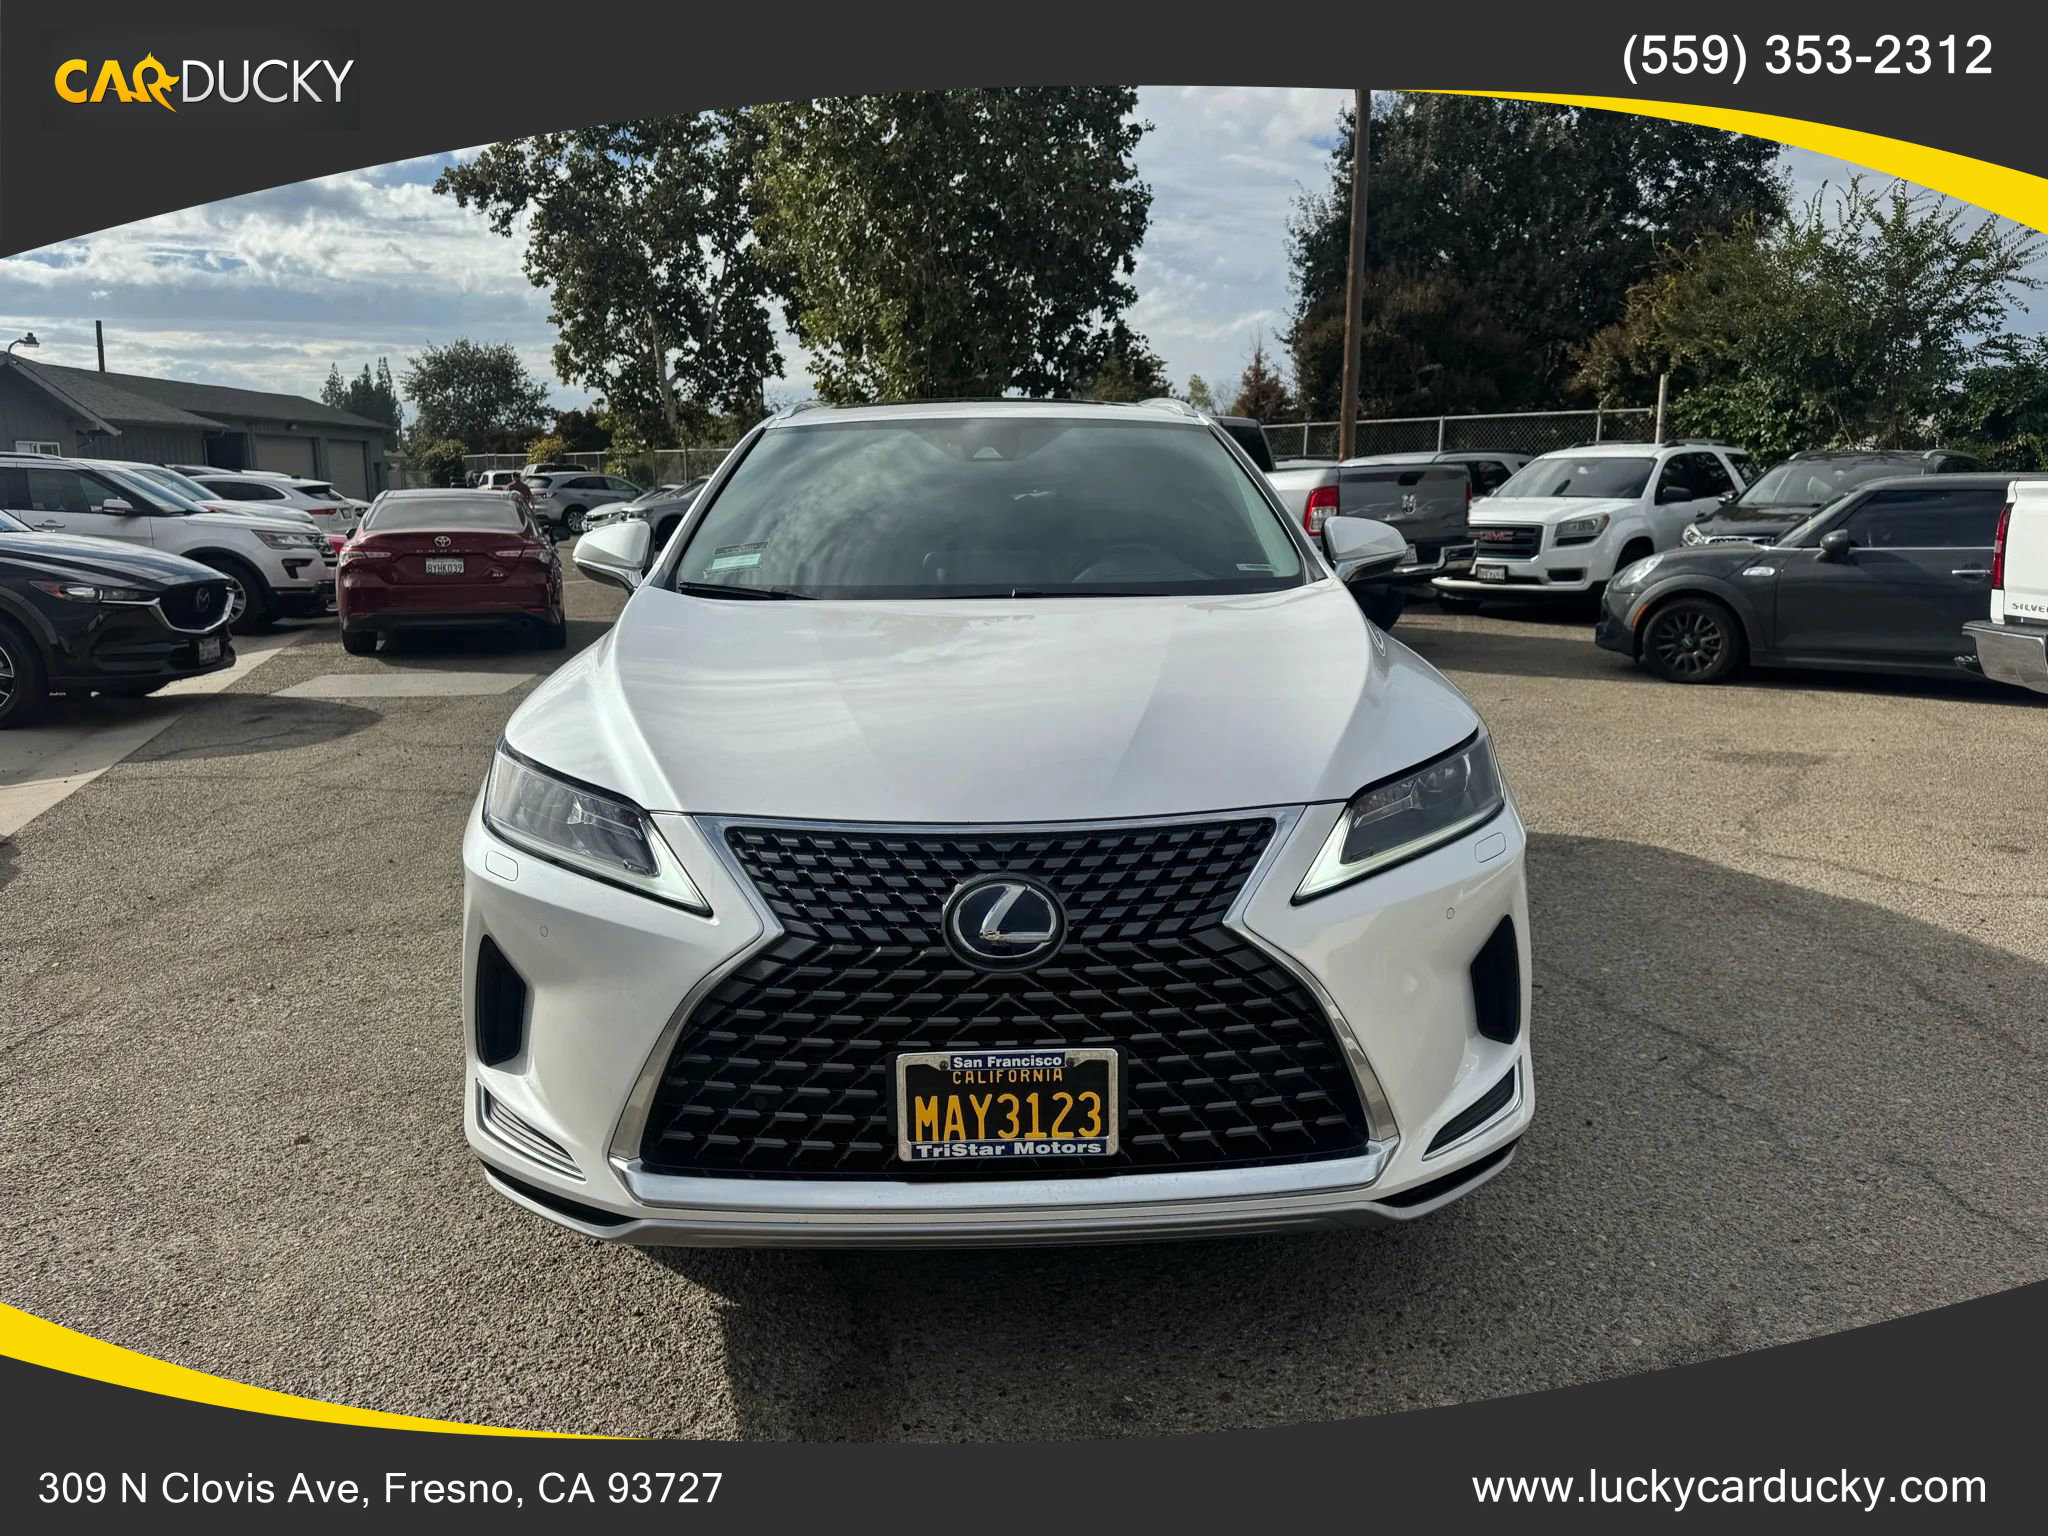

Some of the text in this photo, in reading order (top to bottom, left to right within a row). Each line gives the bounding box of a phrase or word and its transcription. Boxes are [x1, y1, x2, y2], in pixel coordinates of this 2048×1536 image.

[427, 563, 463, 574] 8YHK039
[2012, 602, 2048, 613] SILVE
[953, 1054, 1062, 1069] San Francisco
[952, 1068, 1063, 1085] CALIFORNIA
[914, 1091, 1101, 1142] MAY3123
[916, 1141, 1102, 1158] TriStar Motors
